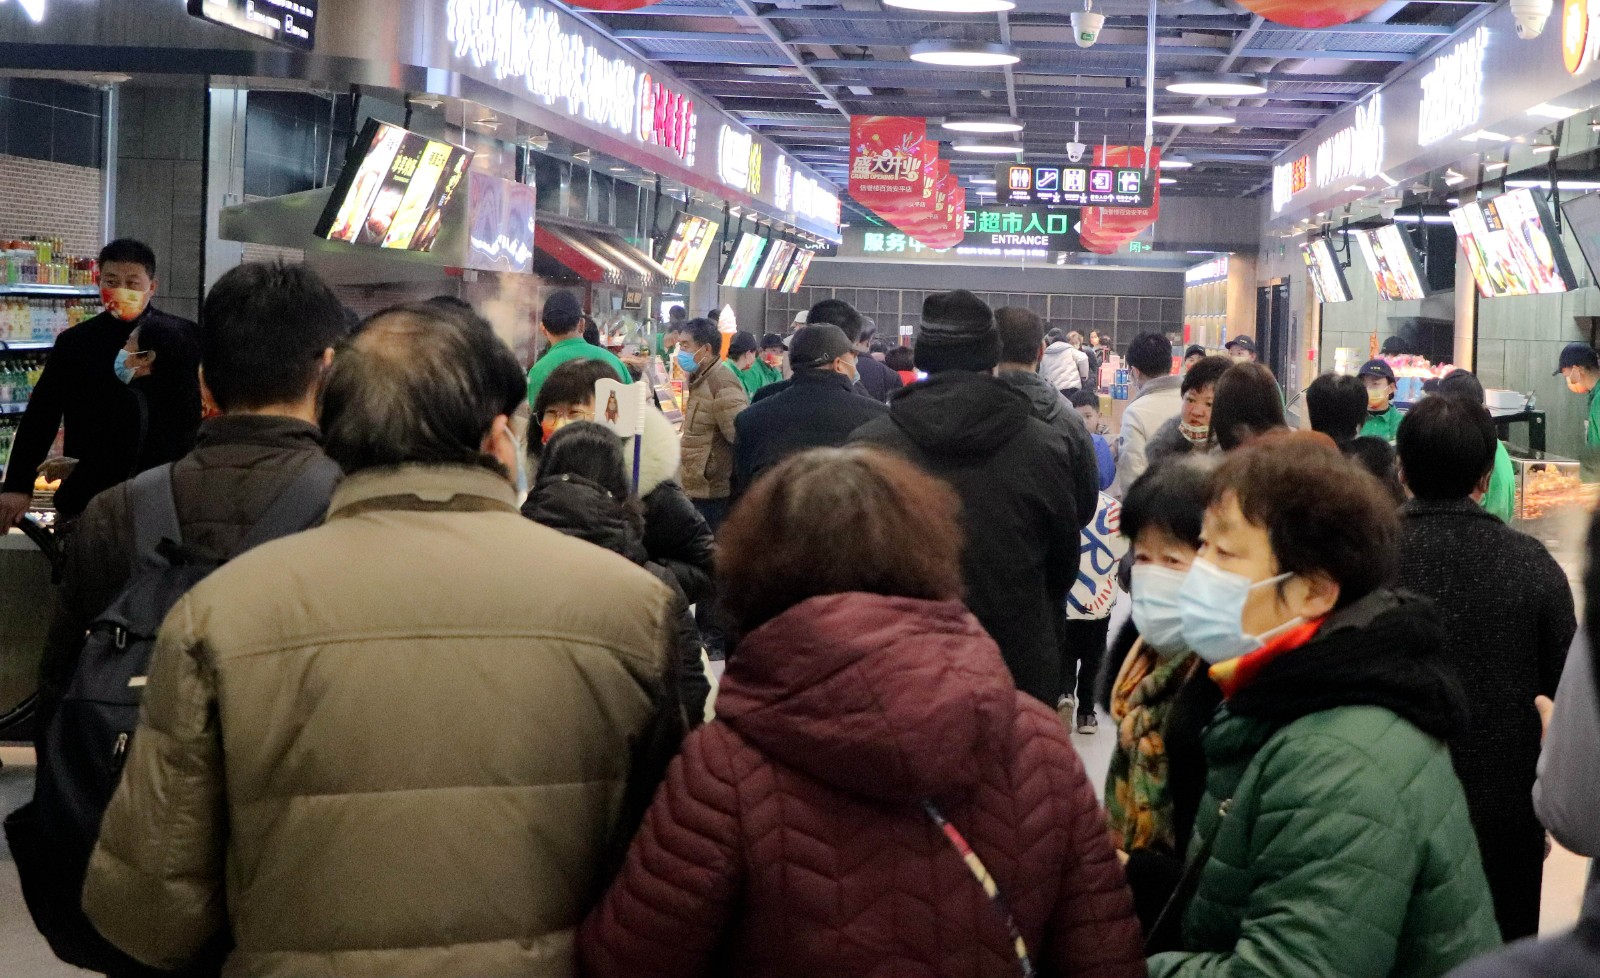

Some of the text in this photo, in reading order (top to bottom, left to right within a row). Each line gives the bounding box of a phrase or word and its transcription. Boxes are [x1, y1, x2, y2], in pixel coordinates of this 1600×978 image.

[853, 152, 922, 182] 盛大开业
[979, 211, 1067, 234] 超市入口
[991, 234, 1049, 246] ENTRANCE
